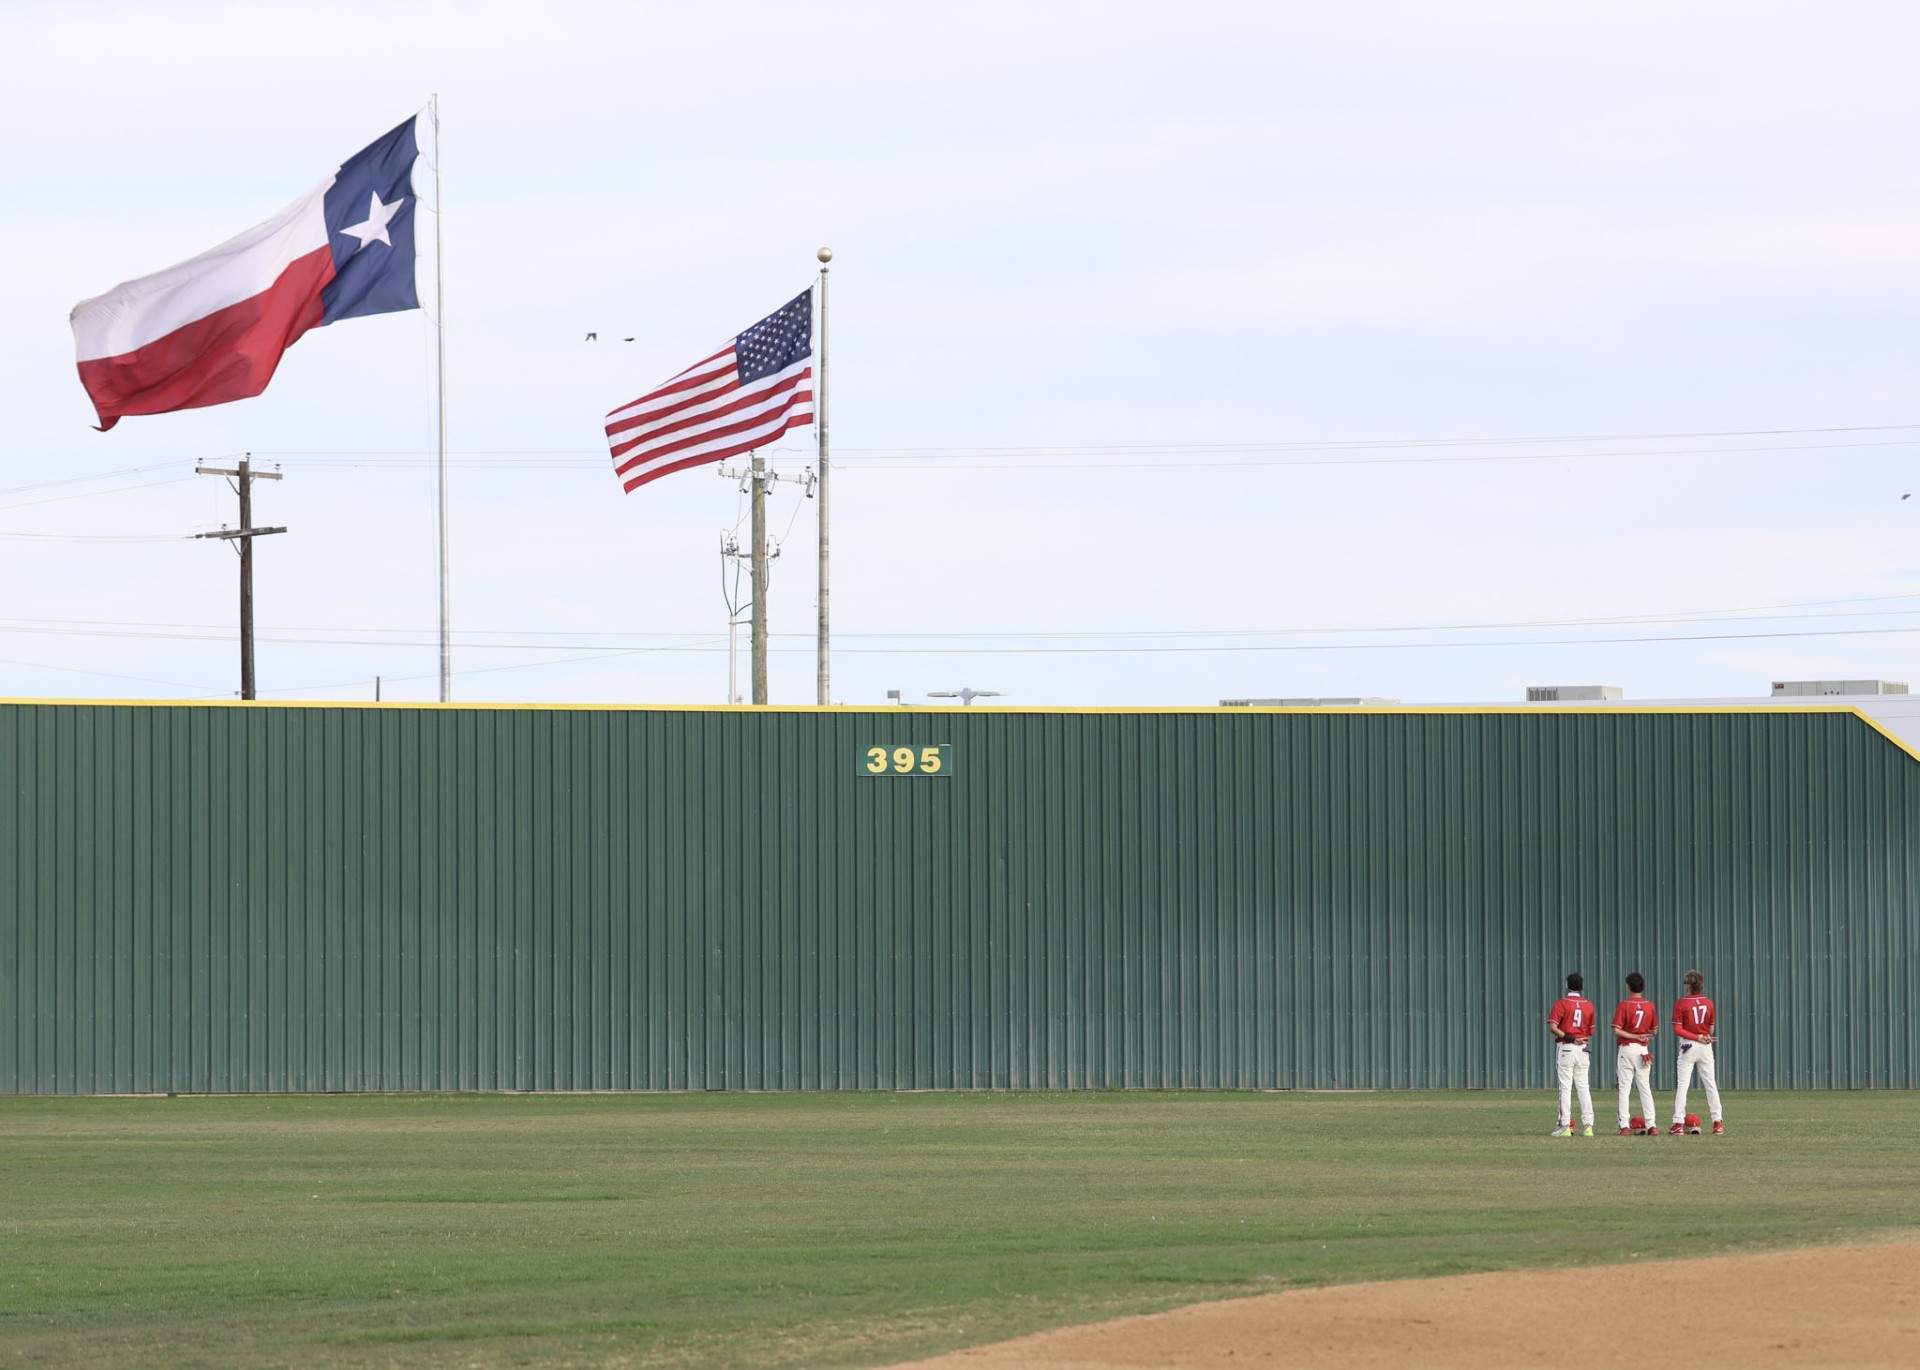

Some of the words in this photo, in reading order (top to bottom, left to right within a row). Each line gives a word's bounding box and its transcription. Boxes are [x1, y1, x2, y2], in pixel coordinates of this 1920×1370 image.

[867, 747, 941, 773] 395
[1572, 1009, 1582, 1028] 9
[1634, 1010, 1644, 1029] 7
[1692, 1005, 1707, 1024] 17
